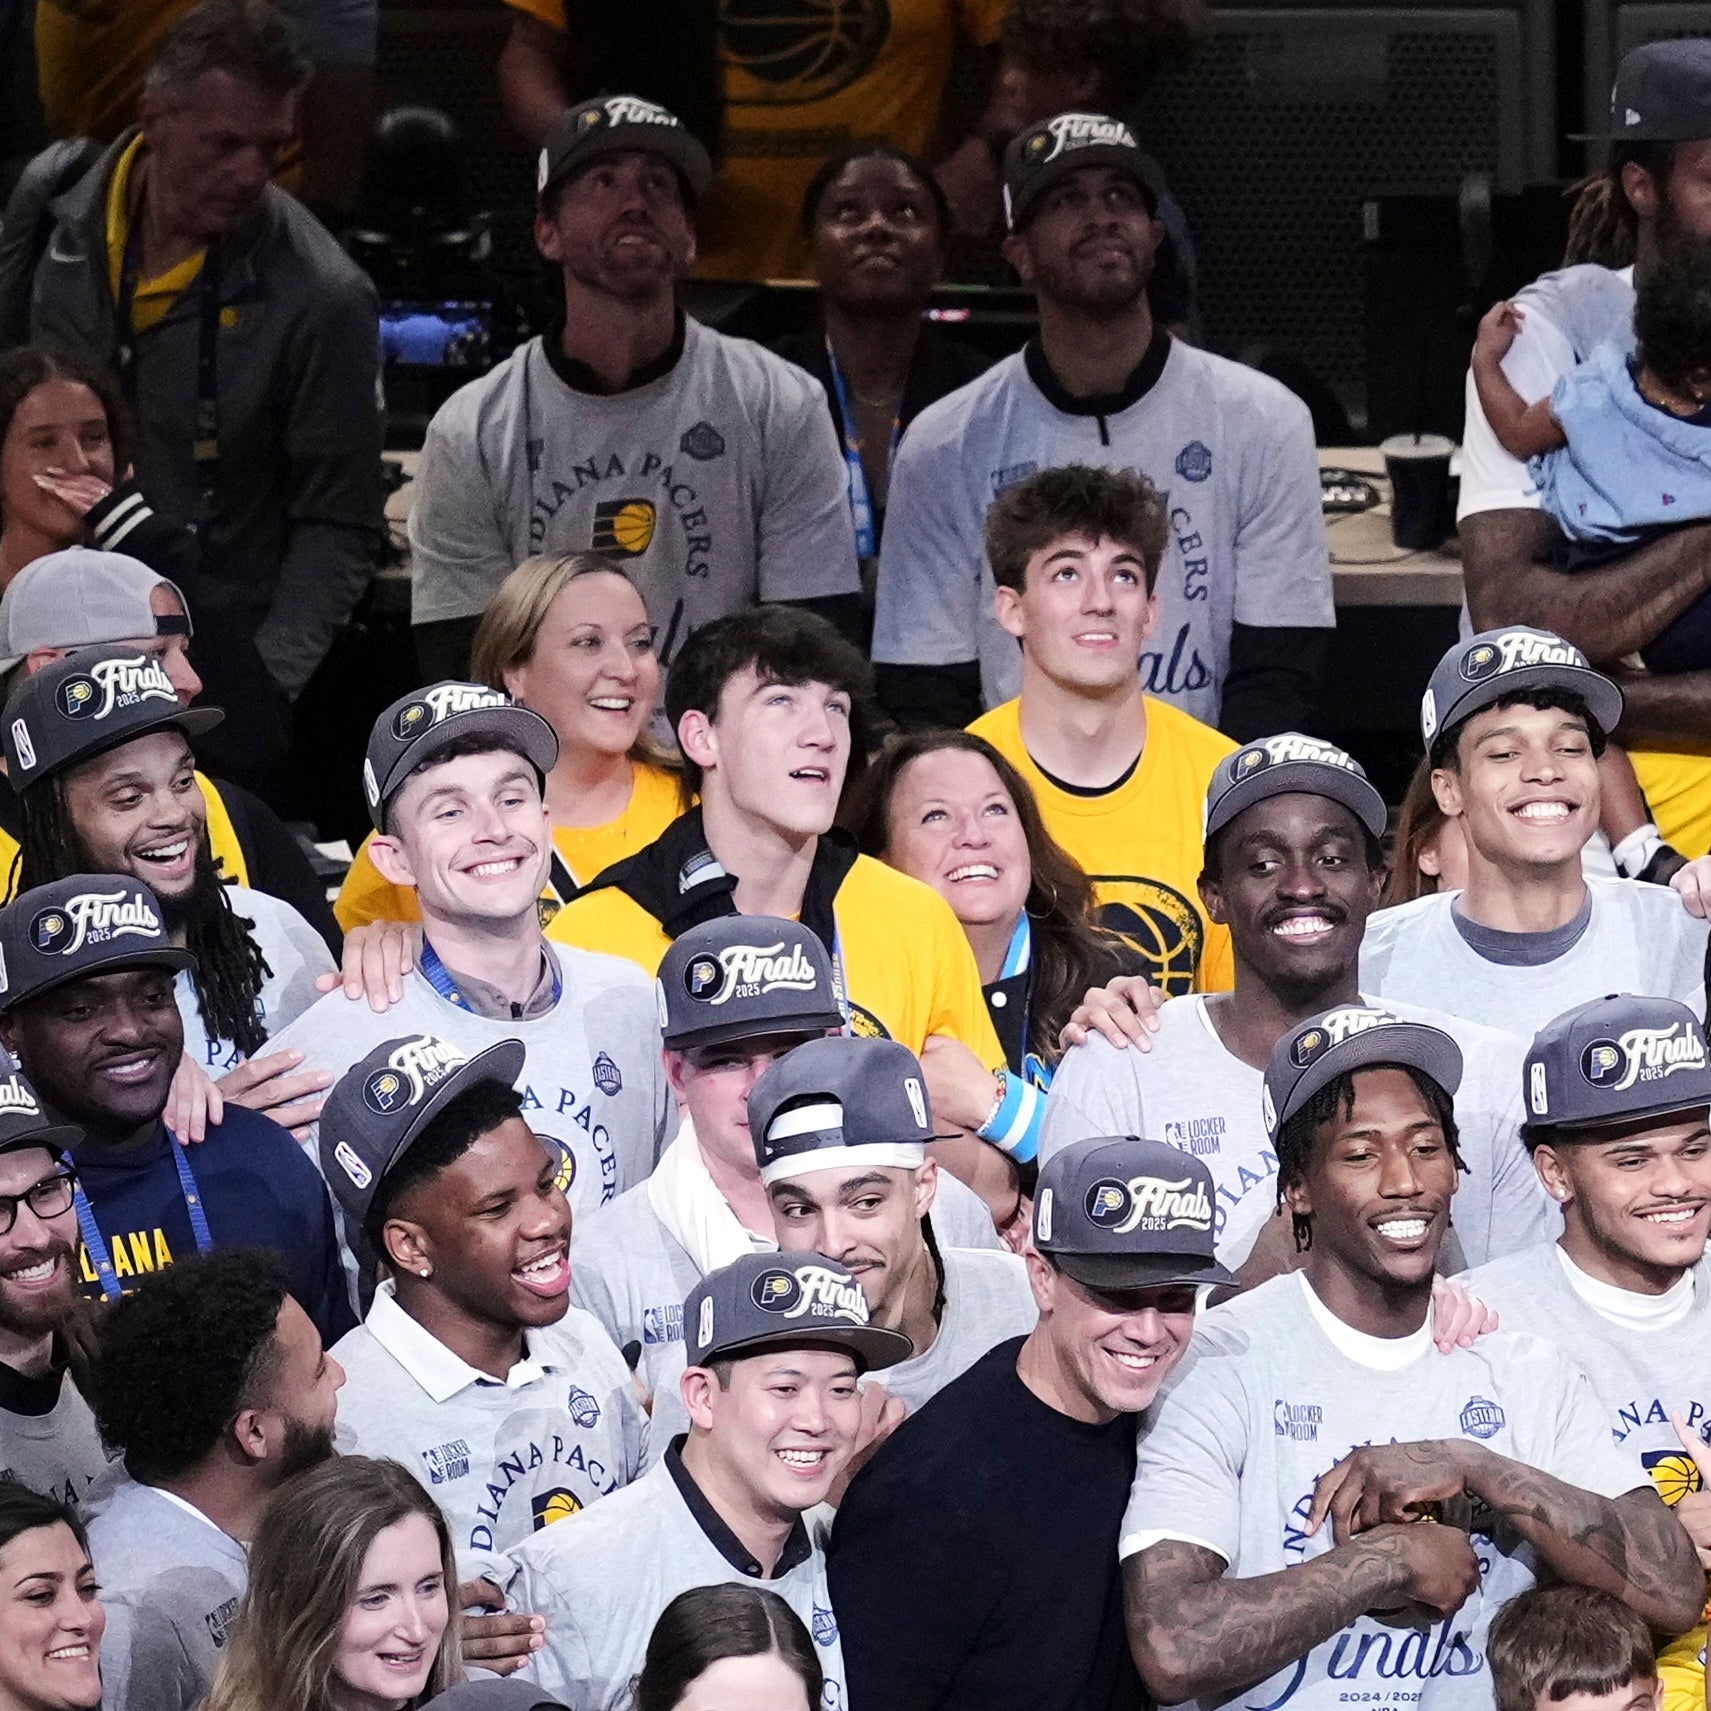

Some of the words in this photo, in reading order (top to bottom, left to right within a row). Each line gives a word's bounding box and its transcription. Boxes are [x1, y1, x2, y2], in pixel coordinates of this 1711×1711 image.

[1045, 115, 1137, 162] Finals
[1496, 633, 1581, 669] Final
[1139, 645, 1213, 692] als
[94, 656, 178, 719] Finals
[116, 691, 140, 708] 2025
[62, 891, 160, 955] Finals
[86, 928, 111, 944] 2025
[709, 941, 816, 1005] Finals
[736, 983, 761, 998] 2025
[1614, 1022, 1705, 1089] Finals
[424, 1067, 446, 1087] 2025
[1640, 1066, 1664, 1082] 2025
[0, 1075, 39, 1115] als
[1188, 1116, 1226, 1138] LOCKER
[557, 1086, 622, 1201] PACER
[1190, 1134, 1220, 1155] ROOM
[1113, 1176, 1213, 1232] Finals
[1141, 1217, 1166, 1231] 2025
[809, 1302, 835, 1316] 2025
[1289, 1405, 1322, 1424] LOCKER
[1290, 1423, 1318, 1441] ROOM
[441, 1439, 472, 1463] LOCKER
[446, 1459, 470, 1482] ROOM
[473, 1443, 543, 1552] DIANA
[1245, 1618, 1483, 1711] inals
